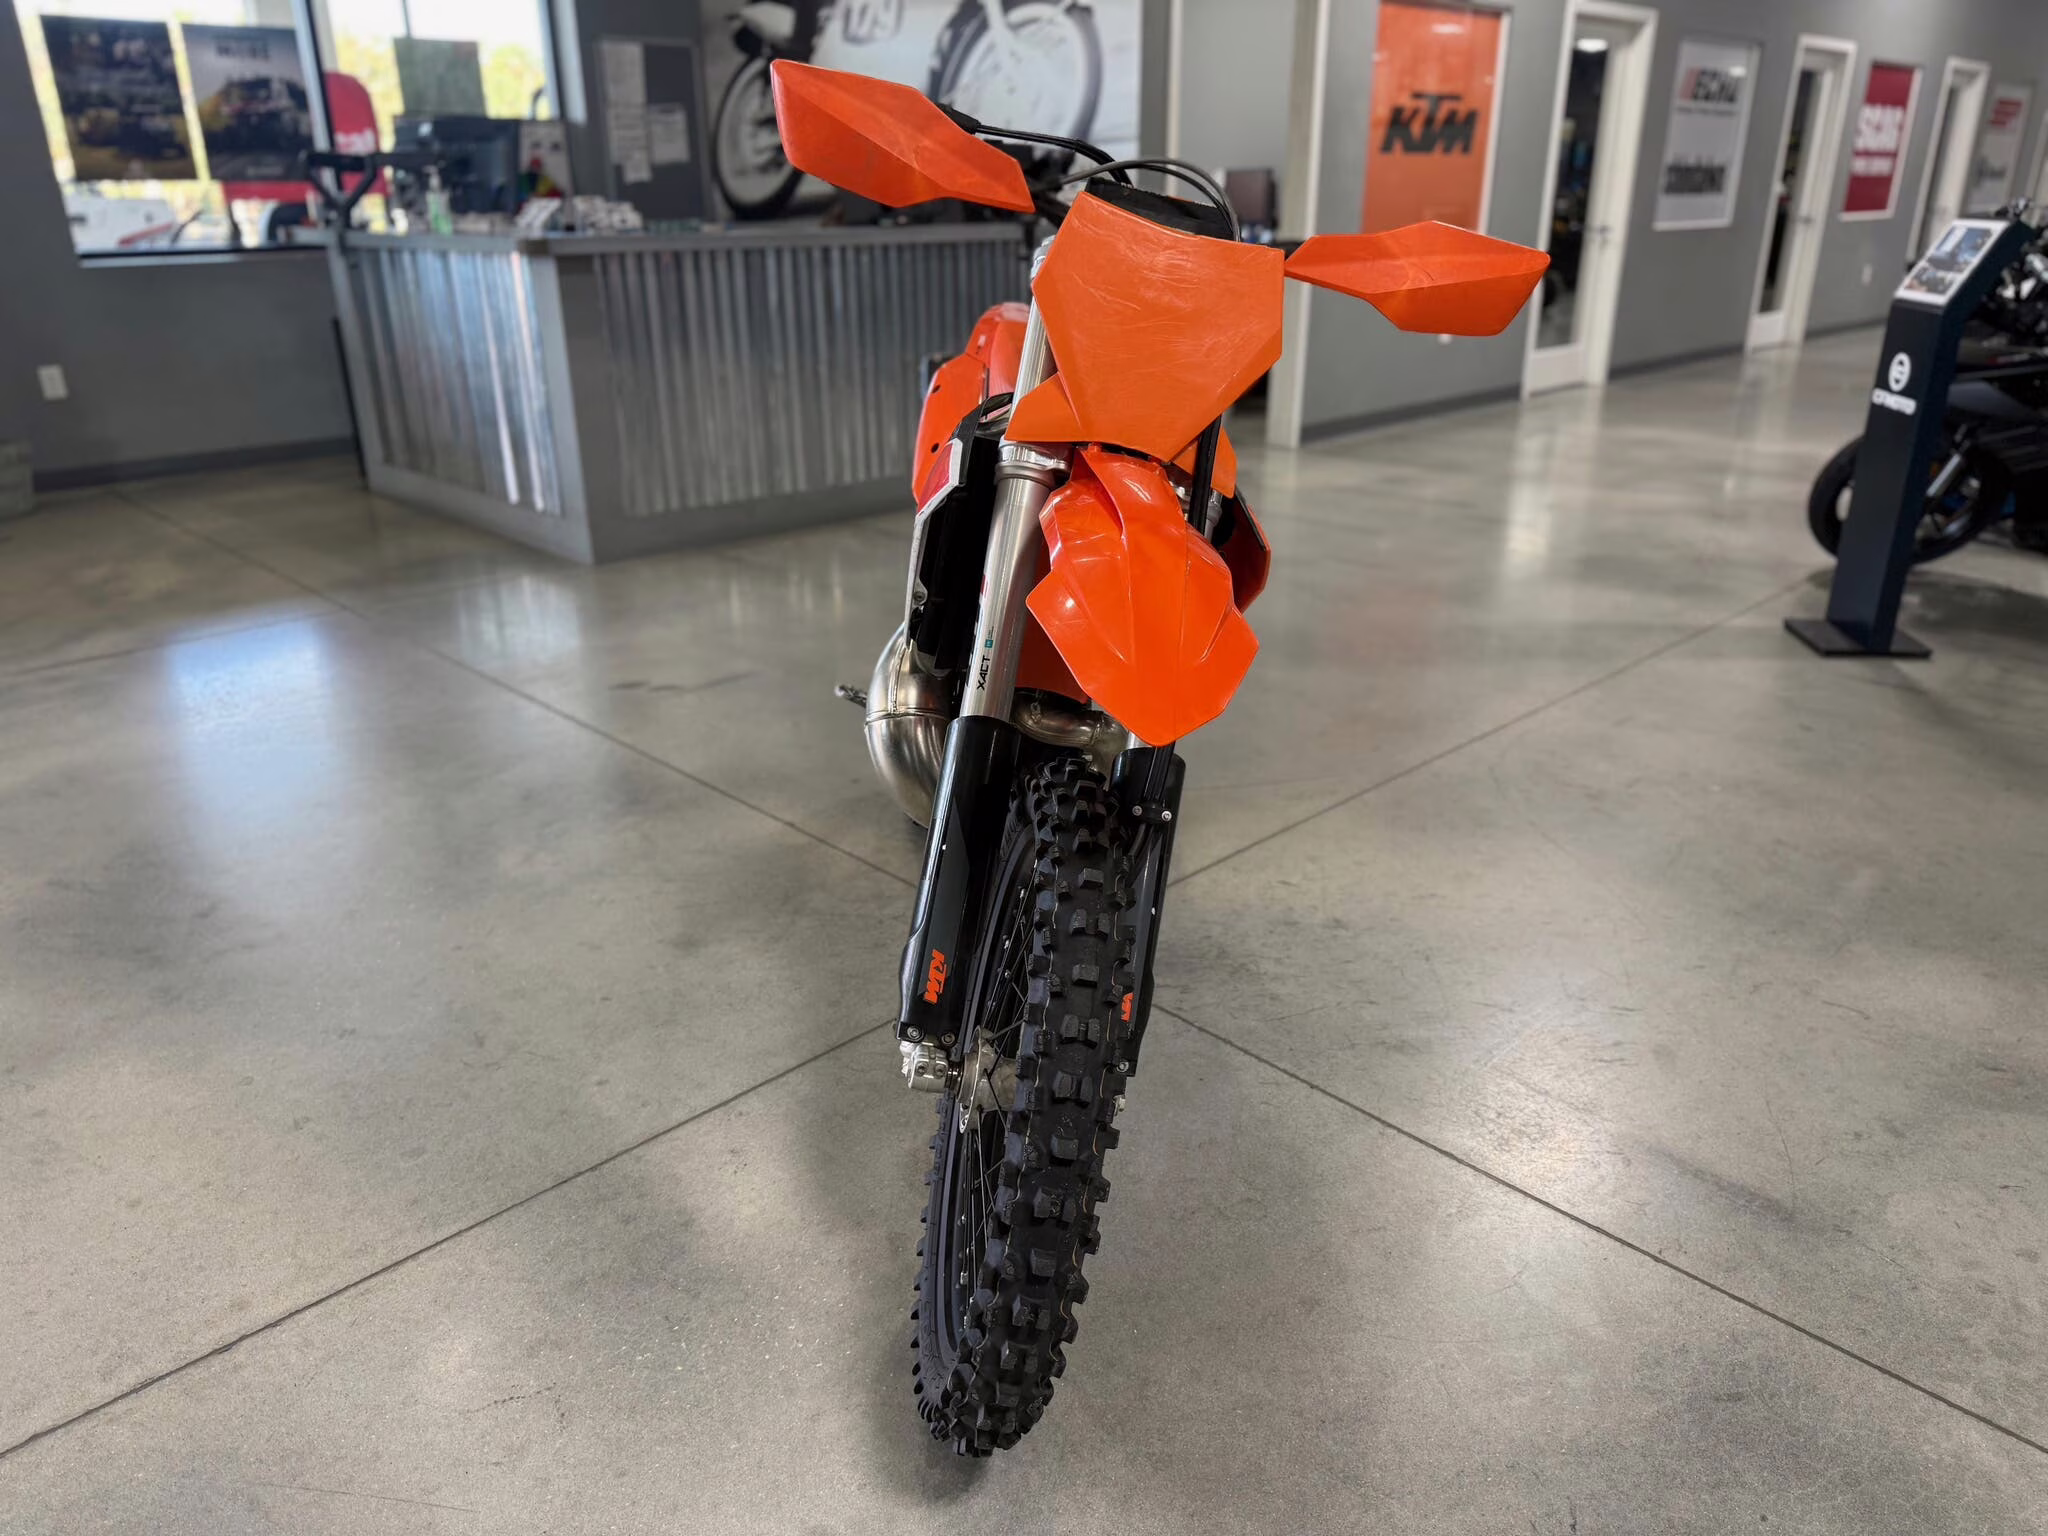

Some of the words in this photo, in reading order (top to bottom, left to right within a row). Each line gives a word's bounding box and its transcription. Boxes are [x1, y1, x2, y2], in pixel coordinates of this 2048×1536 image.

[1380, 93, 1479, 154] KTM
[977, 655, 991, 690] XACT
[924, 949, 947, 1004] KTM
